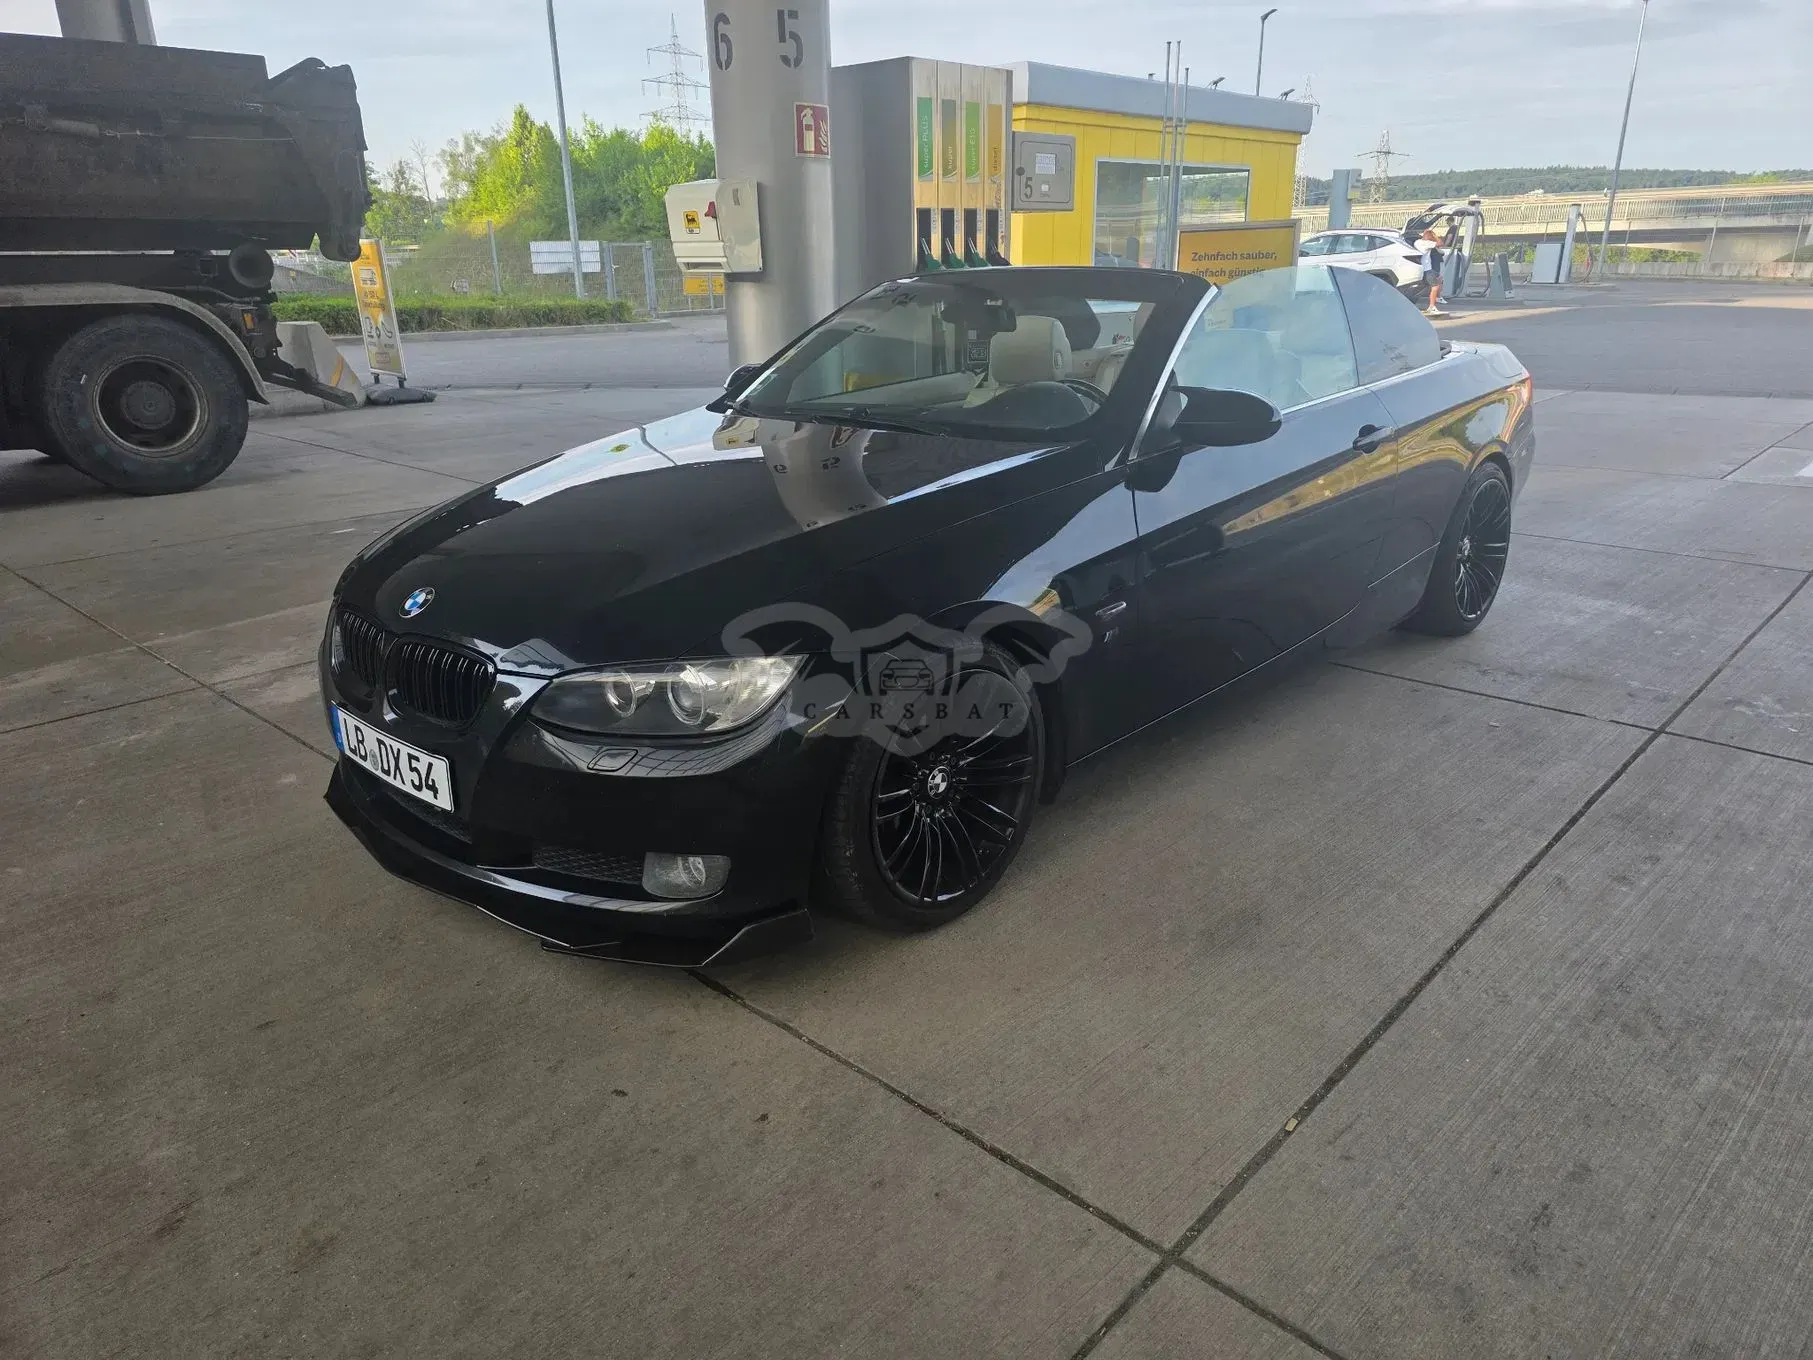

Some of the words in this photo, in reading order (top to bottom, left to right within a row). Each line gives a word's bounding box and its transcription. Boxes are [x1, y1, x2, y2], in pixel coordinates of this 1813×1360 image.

[713, 12, 733, 71] 6
[777, 9, 804, 69] 5
[1024, 176, 1033, 200] 5
[1191, 251, 1238, 262] Zehnfach
[1239, 250, 1278, 262] sauber,
[343, 718, 368, 763] LB
[376, 736, 406, 786] DX
[406, 751, 439, 801] 54
